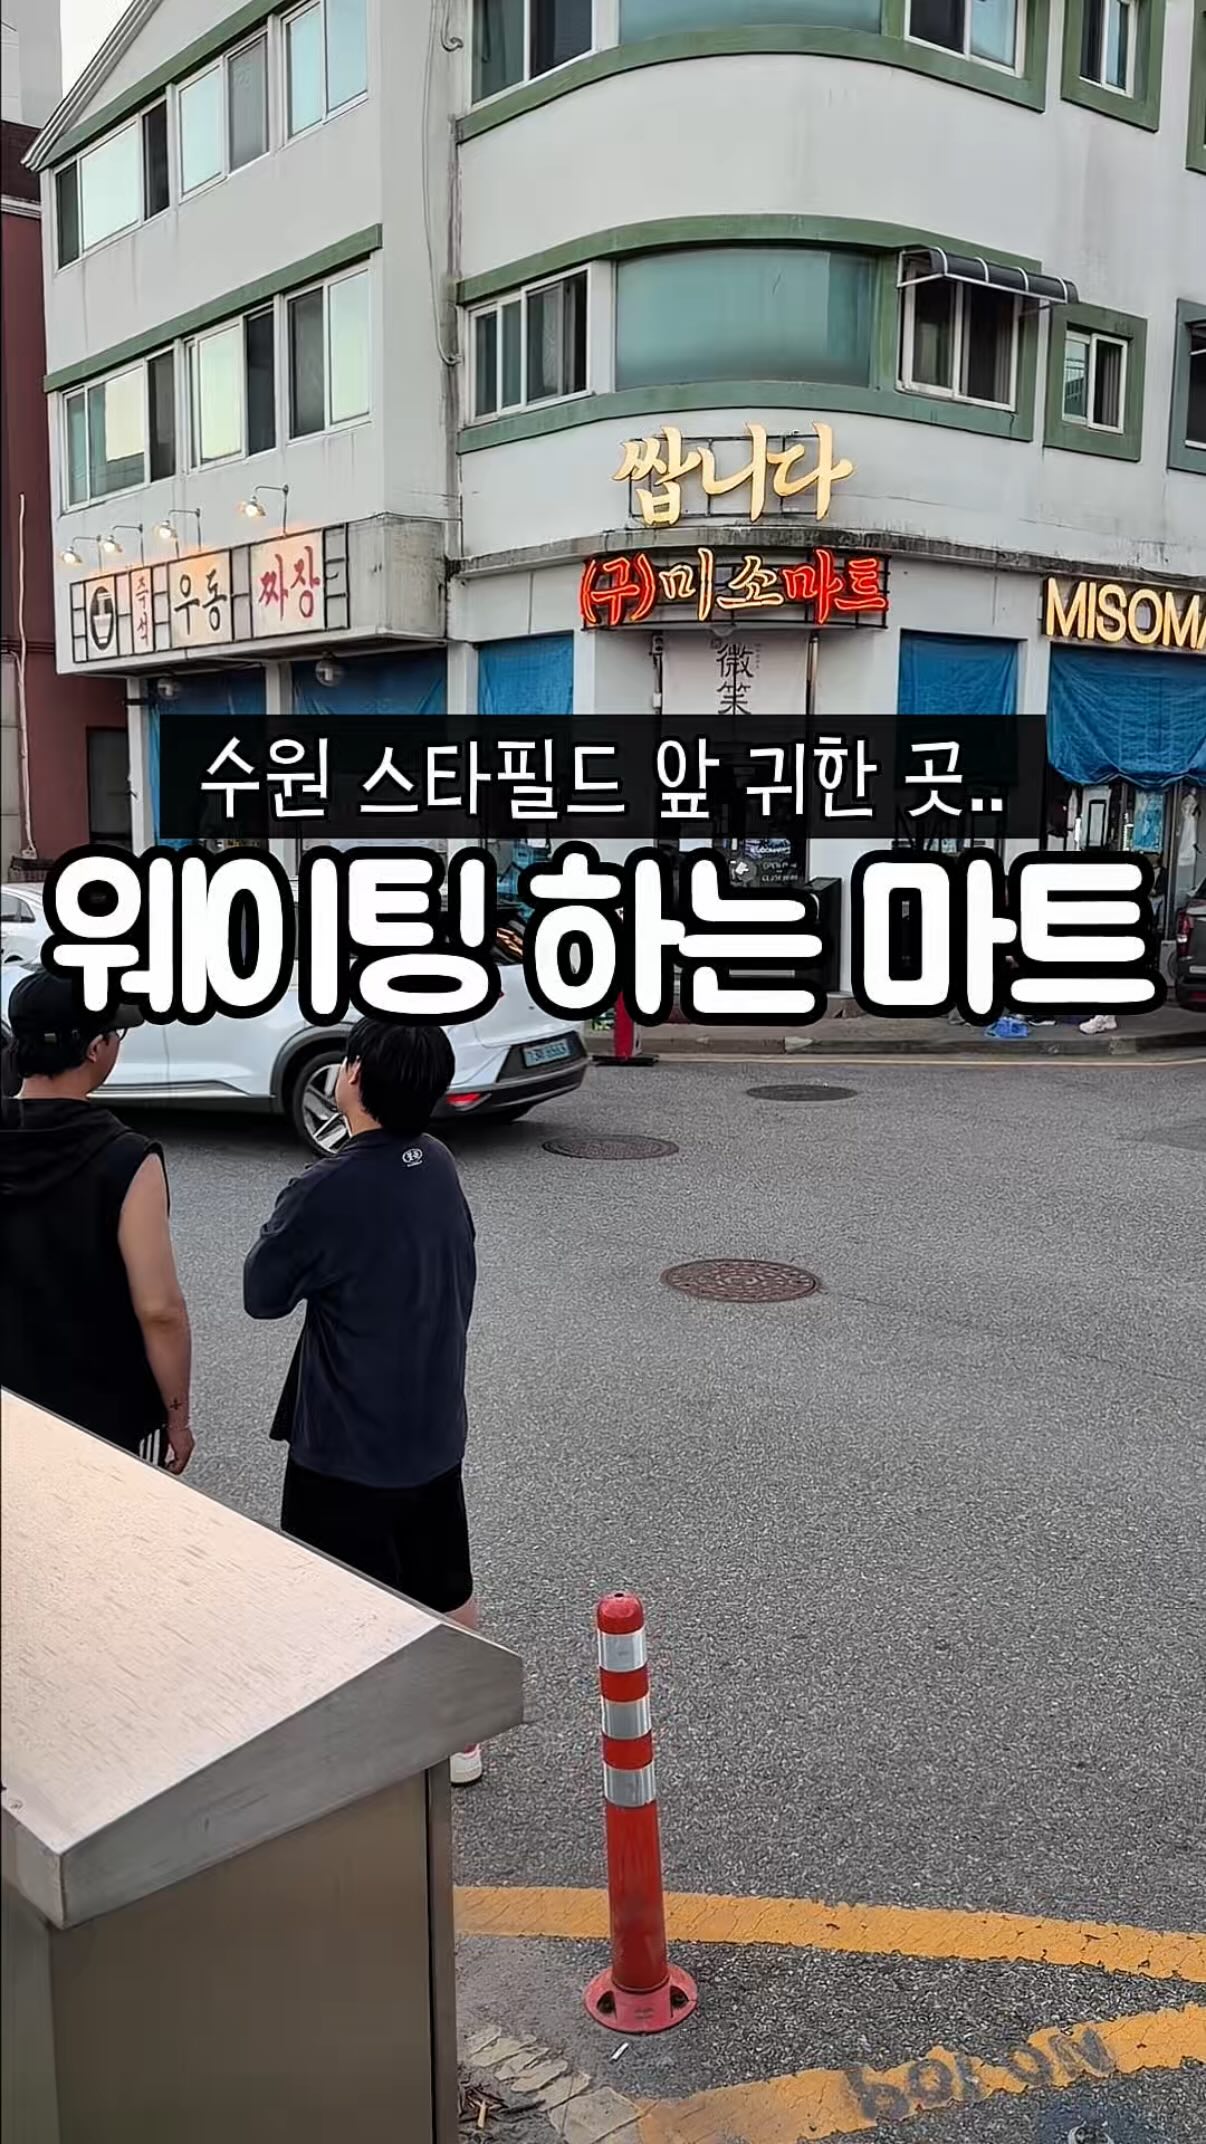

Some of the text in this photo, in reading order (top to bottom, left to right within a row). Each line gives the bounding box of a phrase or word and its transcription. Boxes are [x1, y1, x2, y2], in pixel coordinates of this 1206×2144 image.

[611, 420, 854, 527] 쌉니다
[134, 545, 321, 648] 즉석 우동 짜장
[579, 546, 889, 626] (구)미소마트
